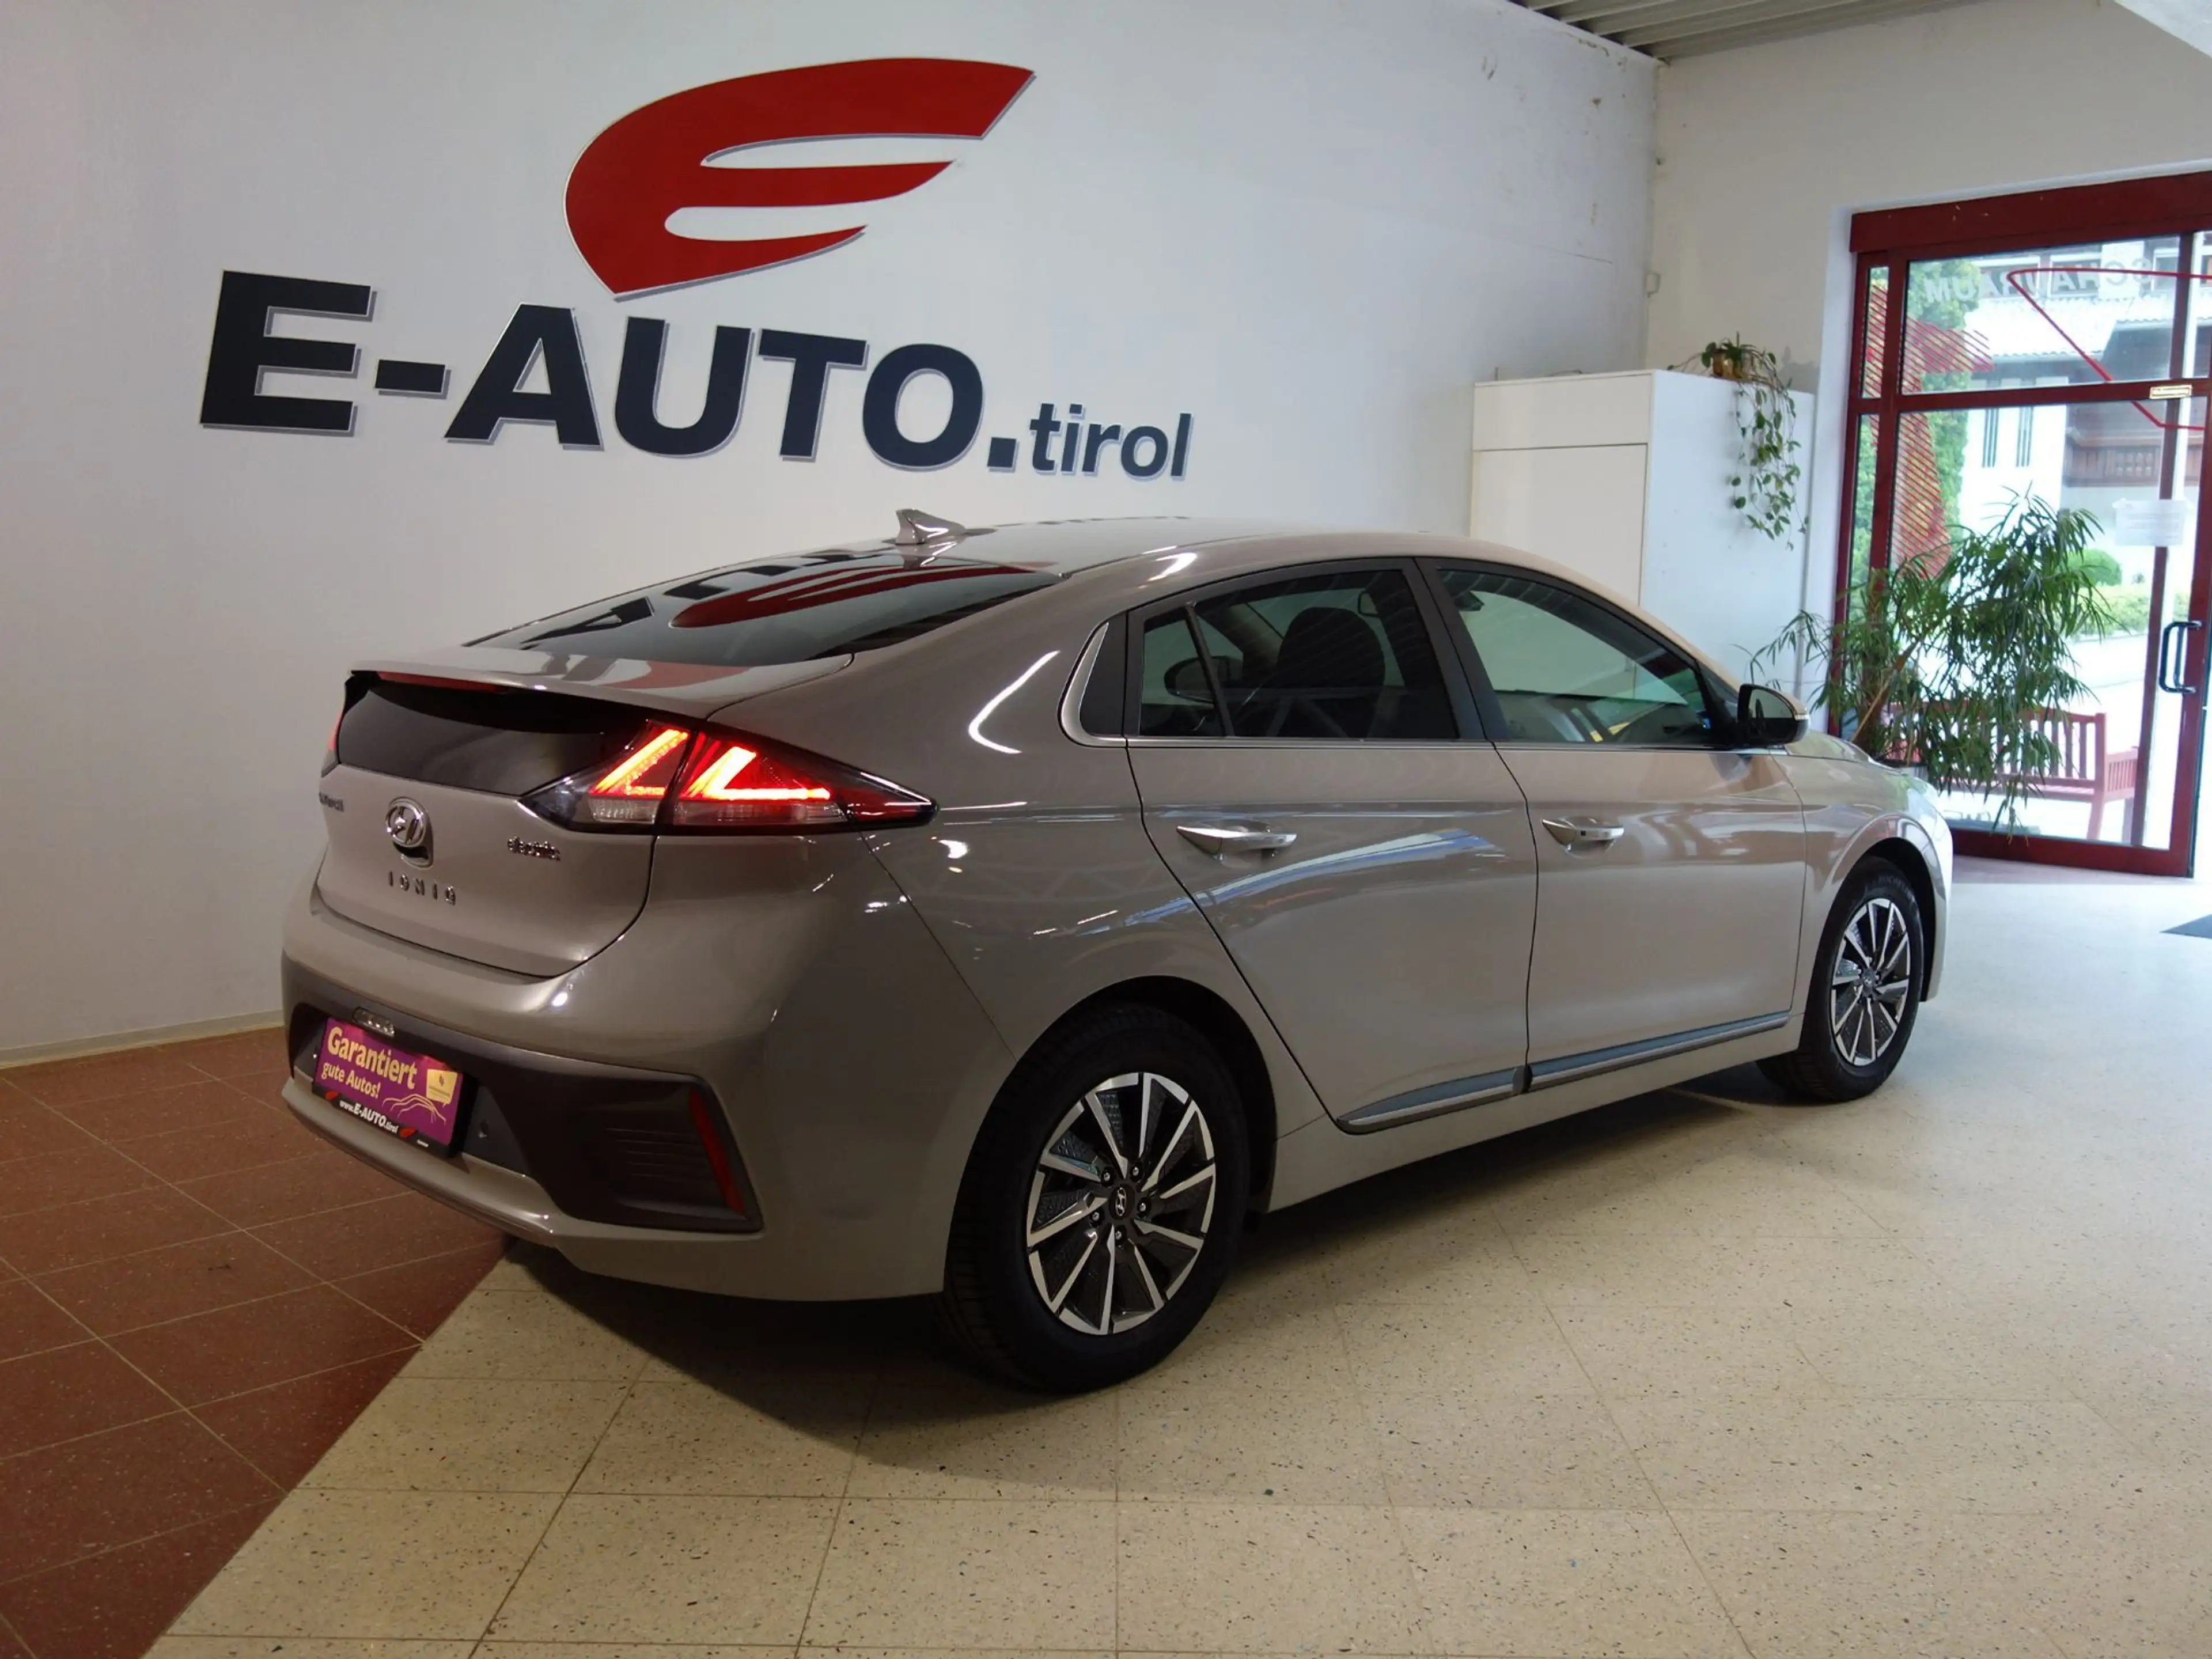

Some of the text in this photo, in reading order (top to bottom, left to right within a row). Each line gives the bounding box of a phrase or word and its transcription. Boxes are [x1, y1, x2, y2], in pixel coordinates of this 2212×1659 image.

[199, 270, 1194, 482] E-AUTO.tirol
[388, 870, 456, 906] IONIQ
[327, 1027, 418, 1090] Garantiert
[321, 1062, 381, 1099] gute Autos!
[339, 1100, 399, 1134] www.E-AUTO.tirol
